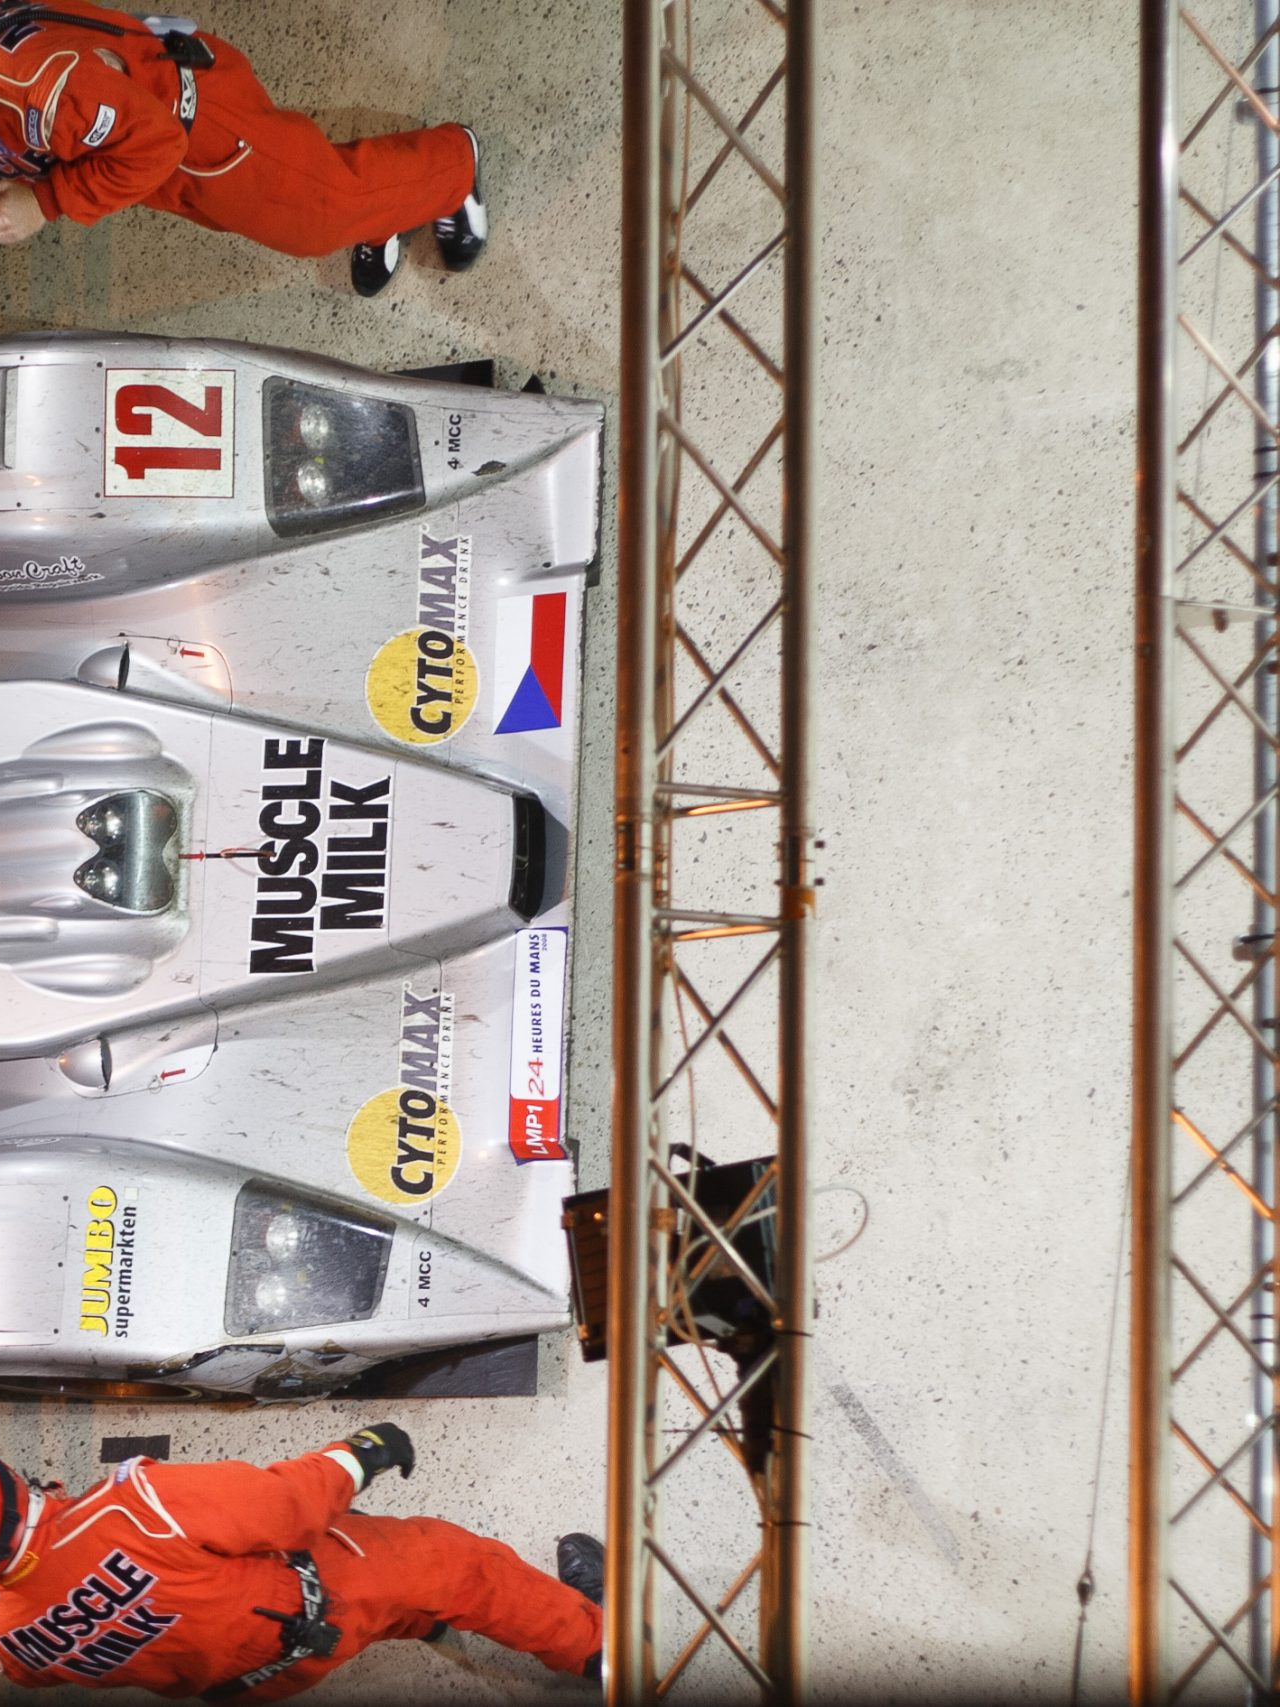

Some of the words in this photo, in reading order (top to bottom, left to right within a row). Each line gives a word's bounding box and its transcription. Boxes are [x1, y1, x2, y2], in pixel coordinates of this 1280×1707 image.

[114, 384, 223, 480] 12
[448, 413, 462, 452] MCC
[447, 457, 460, 470] 4
[459, 536, 470, 584] DRINK
[410, 532, 461, 735] CYTOMAX
[454, 591, 467, 706] PERFORMANCE
[248, 736, 325, 974] MUSCLE
[319, 775, 392, 930] MILK
[529, 933, 541, 974] MANS
[530, 979, 542, 998] DU
[442, 993, 454, 1042] DRINK
[531, 1003, 543, 1053] HEURES
[391, 989, 441, 1195] CYTOMAX
[527, 1059, 545, 1098] 24
[437, 1052, 450, 1165] PERFORMANCE
[526, 1103, 549, 1157] LMP1
[79, 1185, 118, 1338] JUMBO
[115, 1205, 137, 1339] supermarkten
[419, 1250, 431, 1290] MCC
[418, 1296, 430, 1308] 4
[59, 1603, 183, 1679] MILK
